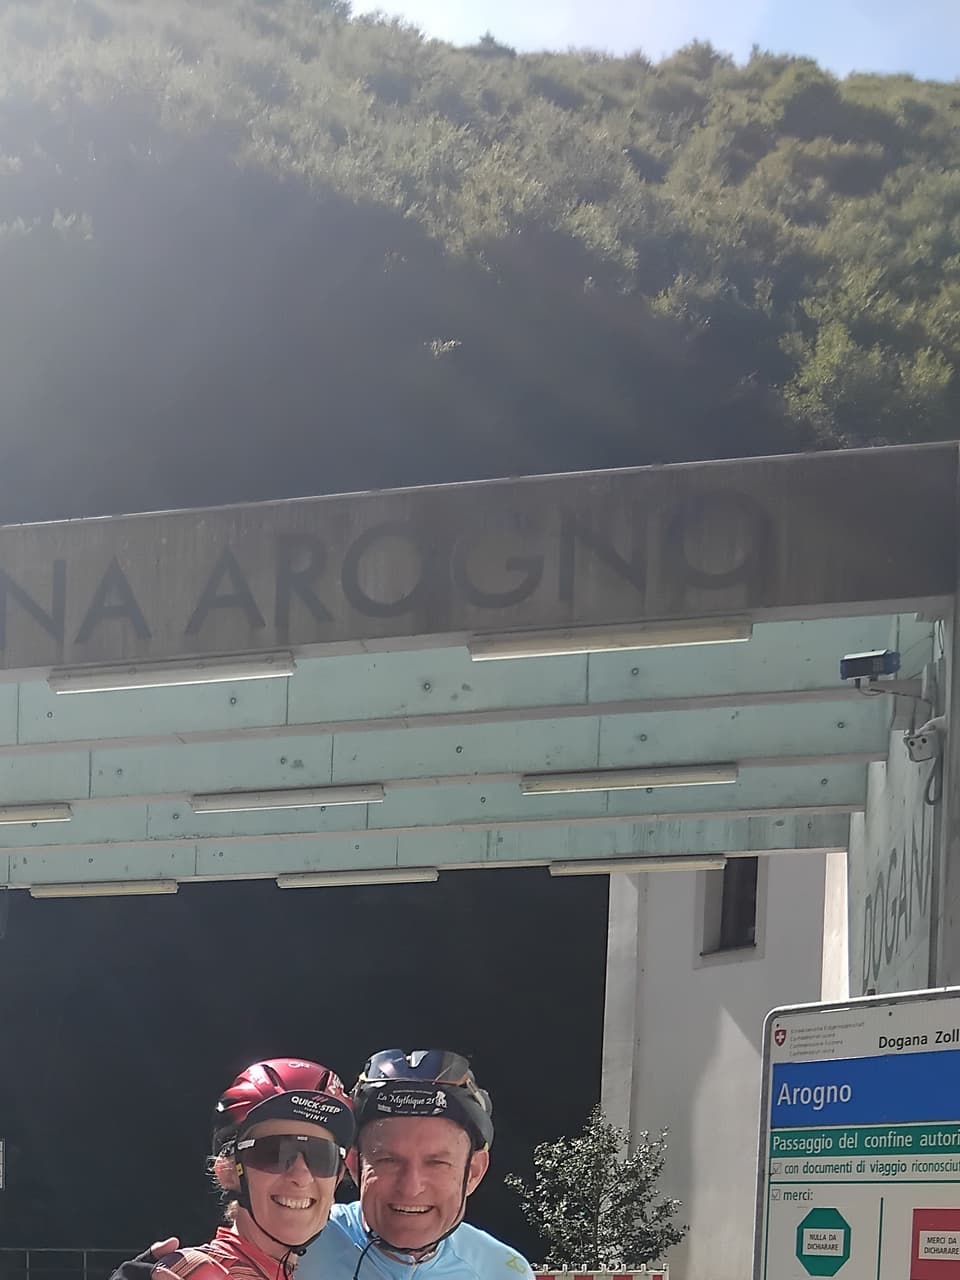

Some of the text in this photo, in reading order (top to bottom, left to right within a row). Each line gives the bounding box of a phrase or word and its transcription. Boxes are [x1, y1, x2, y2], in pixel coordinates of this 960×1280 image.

[185, 491, 762, 637] AROGNO
[862, 800, 933, 995] DOGAN
[878, 1028, 960, 1050] Dogana Zoll
[777, 1082, 852, 1110] Arogno
[773, 1133, 833, 1153] Passaggio
[838, 1132, 858, 1148] del
[864, 1130, 913, 1148] confine
[784, 1164, 799, 1175] con
[802, 1161, 853, 1174] documenti
[856, 1160, 866, 1173] di
[870, 1160, 907, 1176] viaggio
[783, 1188, 814, 1201] merci:
[924, 1246, 960, 1255] DICHIARARE
[927, 1236, 957, 1245] MERCI DA
